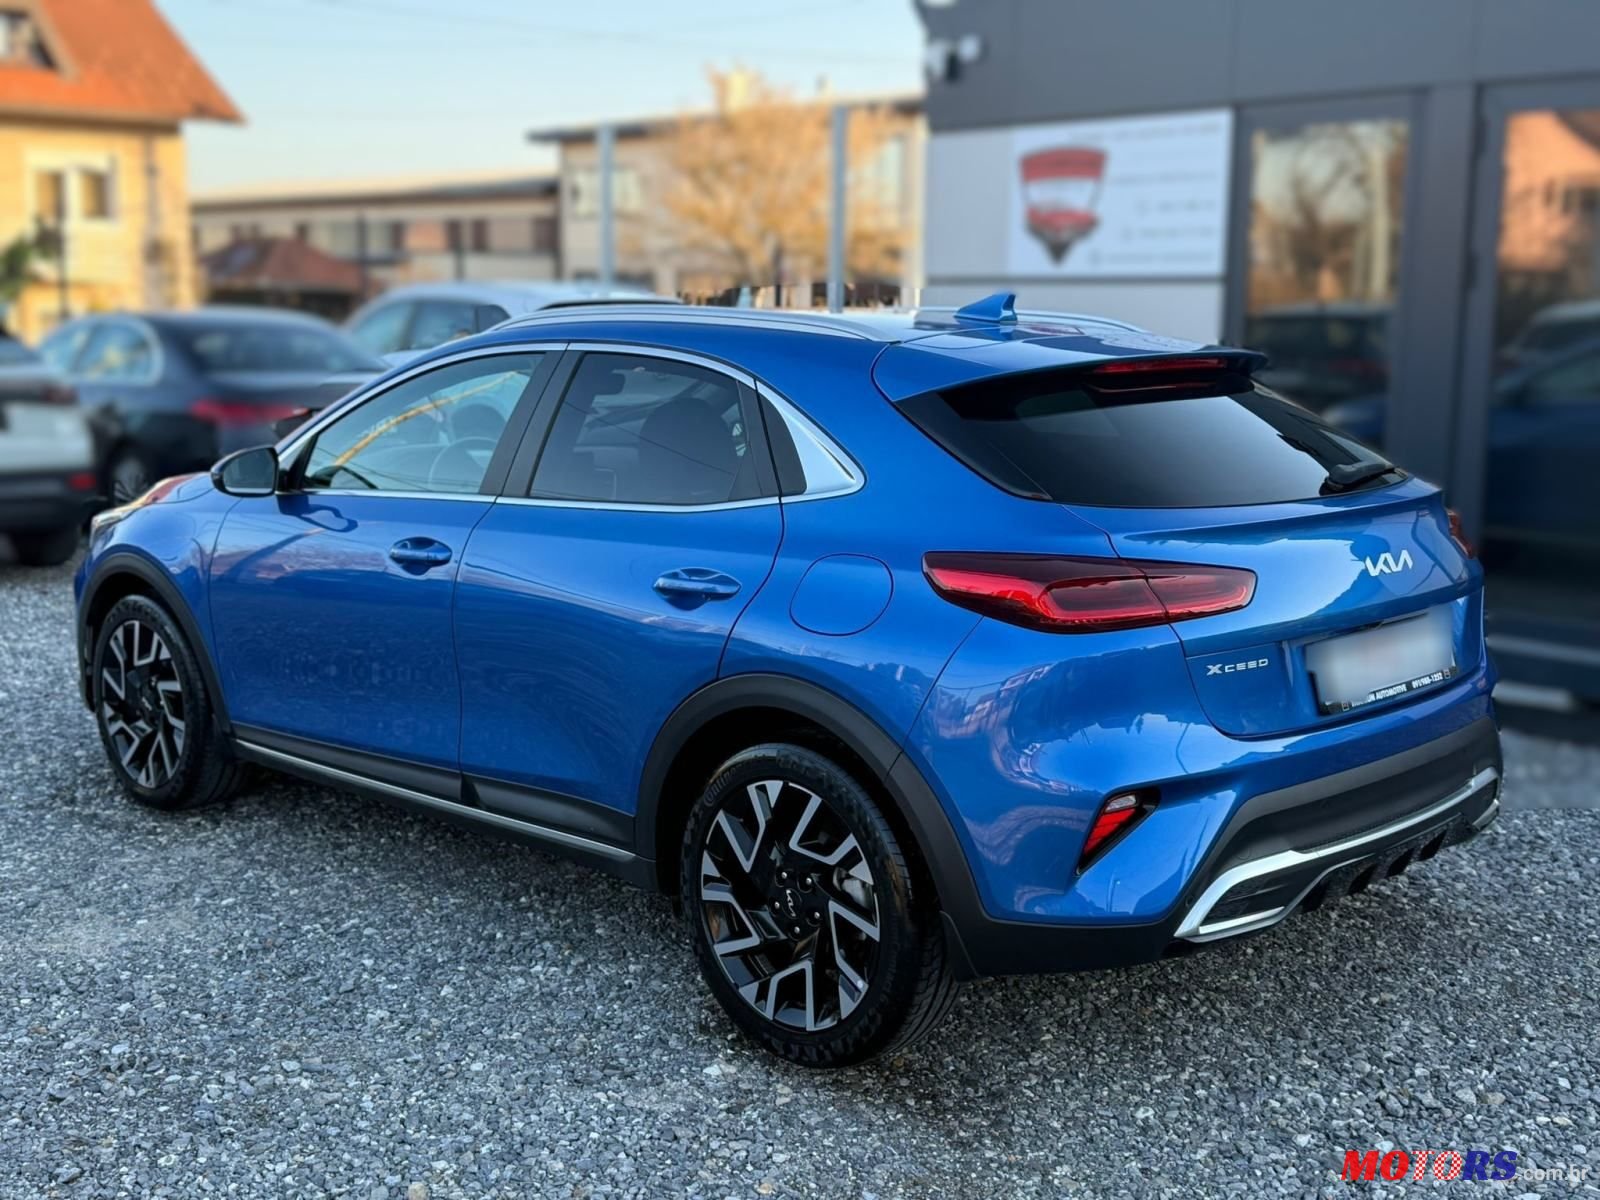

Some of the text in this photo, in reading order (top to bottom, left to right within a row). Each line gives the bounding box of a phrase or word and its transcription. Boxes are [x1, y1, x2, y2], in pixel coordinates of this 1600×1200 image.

[1364, 549, 1413, 577] KIA
[1206, 658, 1269, 676] XCEED
[1376, 683, 1407, 700] AUTOMOTIVE
